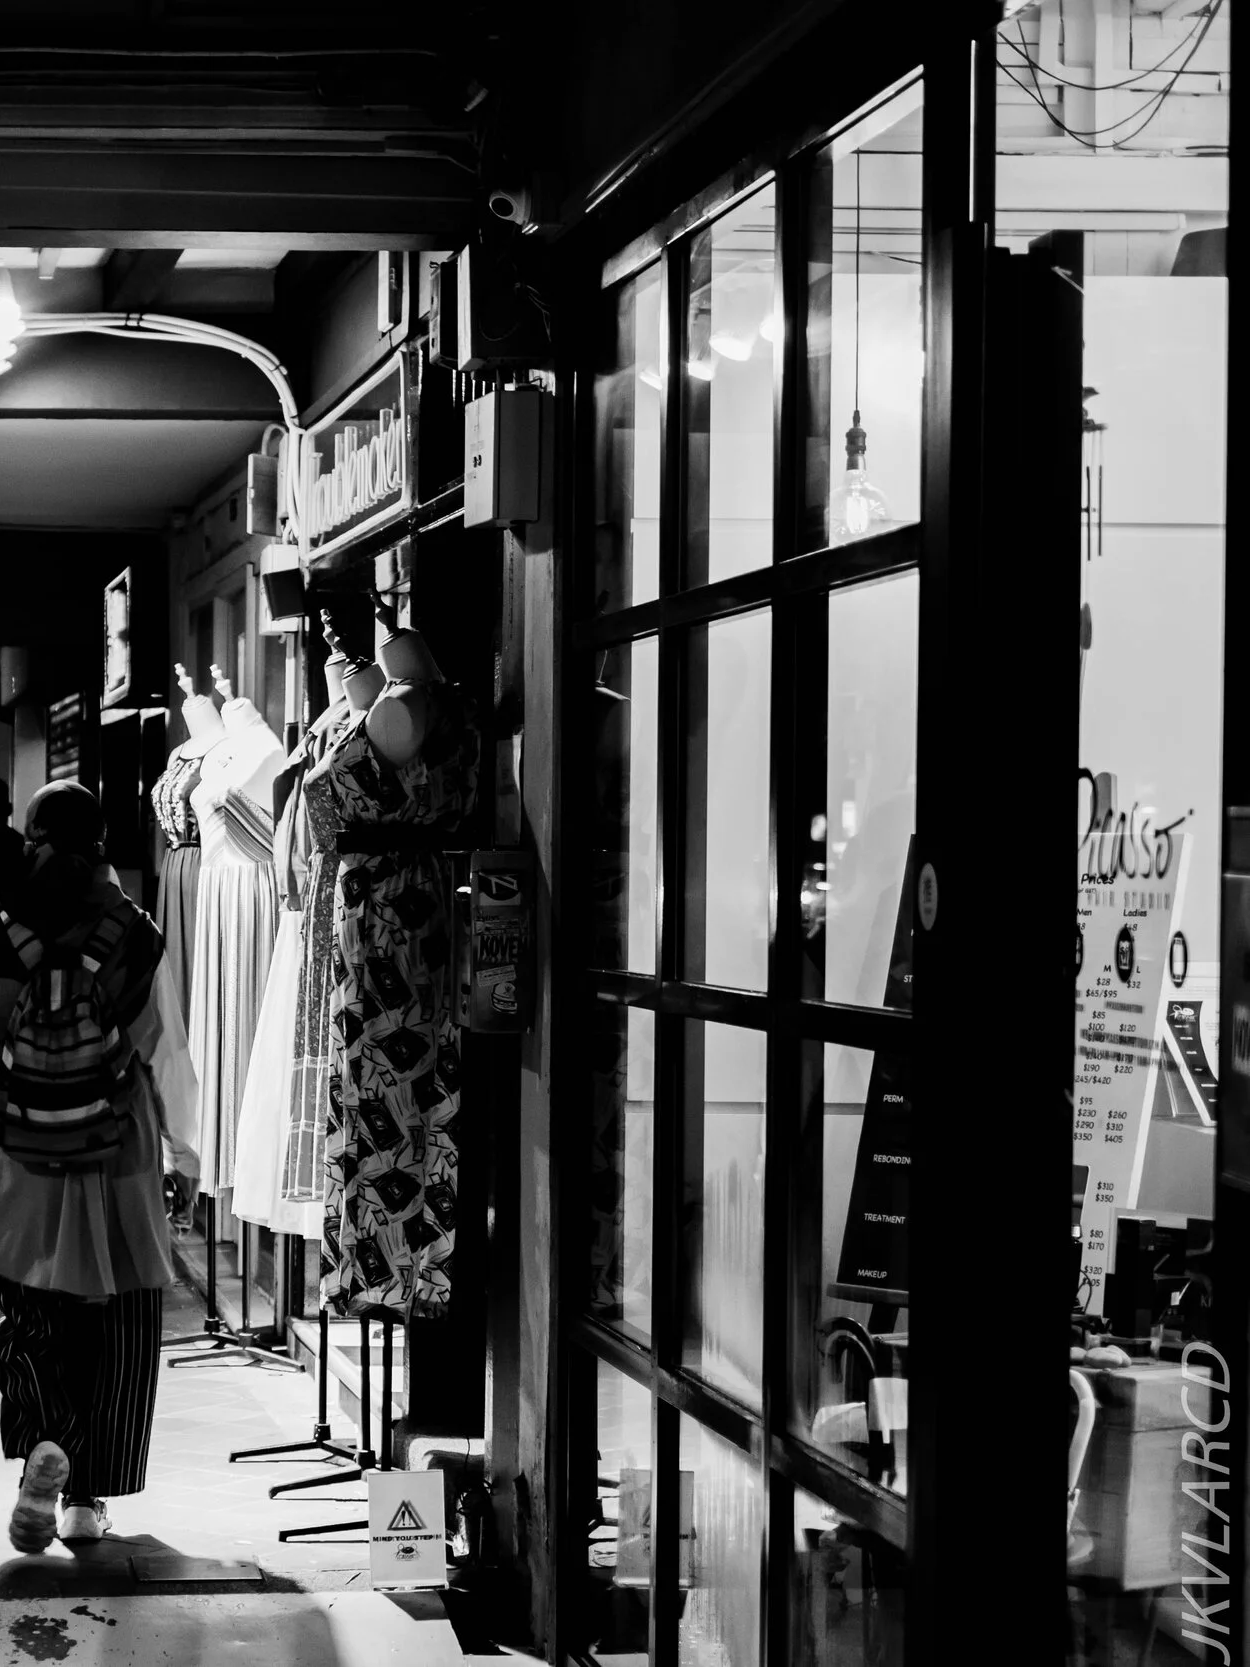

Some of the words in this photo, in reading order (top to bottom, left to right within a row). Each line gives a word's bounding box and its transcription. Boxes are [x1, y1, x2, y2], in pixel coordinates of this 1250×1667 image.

[1081, 873, 1115, 885] Prices
[1077, 908, 1092, 916] Men
[1123, 909, 1147, 917] Ladies
[1136, 966, 1141, 974] L
[1097, 977, 1111, 986] $28
[1127, 979, 1141, 989] $32
[1086, 989, 1117, 998] $65/$95
[1092, 1010, 1106, 1019] $85
[1088, 1023, 1105, 1032] $100
[1119, 1023, 1136, 1033] $120
[1083, 1064, 1100, 1073] $190
[1114, 1065, 1133, 1074] $220
[1075, 1076, 1111, 1085] 245/$420
[883, 1094, 903, 1104] PERM
[1080, 1097, 1093, 1106] $95
[1077, 1109, 1096, 1118] $230
[1108, 1111, 1127, 1120] $260
[1075, 1120, 1094, 1129] $290
[1106, 1122, 1123, 1132] $310
[1073, 1132, 1092, 1141] $350
[1105, 1134, 1123, 1143] $405
[873, 1154, 911, 1165] REBONDIN
[1097, 1181, 1114, 1191] $310
[1095, 1193, 1114, 1203] $350
[864, 1212, 906, 1224] TREATMENT
[1090, 1229, 1103, 1238] $80
[1088, 1241, 1104, 1250] $170
[857, 1269, 887, 1279] MAKEUP
[1084, 1265, 1102, 1275] $320
